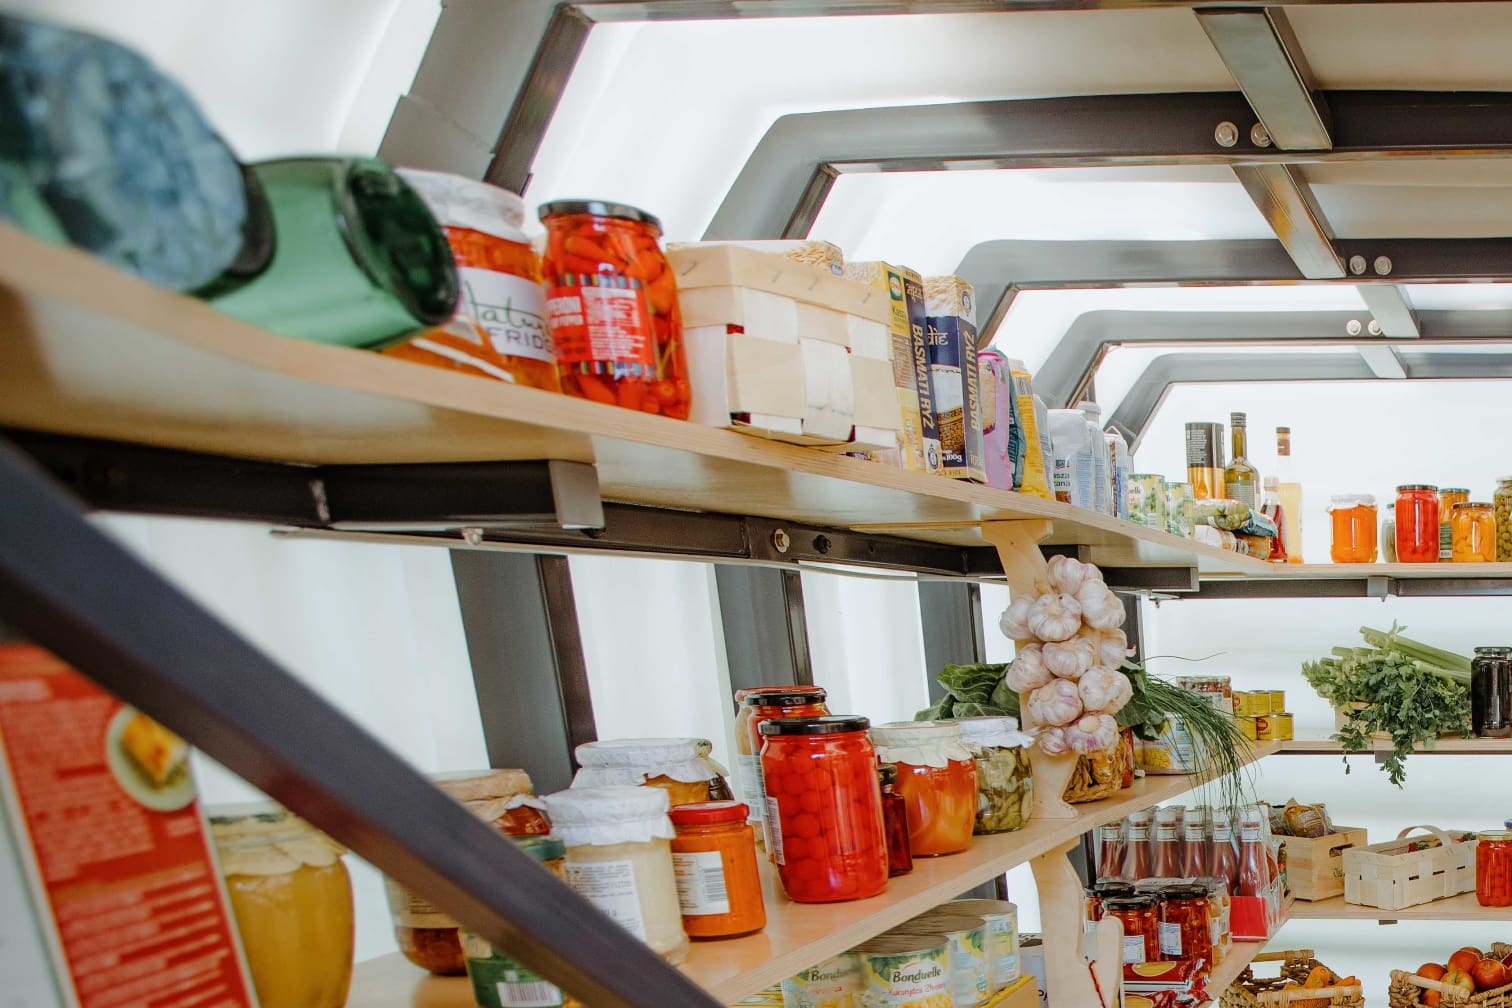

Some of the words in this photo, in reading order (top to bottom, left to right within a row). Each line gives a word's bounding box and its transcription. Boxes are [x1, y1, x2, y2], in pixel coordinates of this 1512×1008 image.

[912, 323, 930, 392] BASMATI
[963, 365, 979, 431] BASMATI
[892, 965, 942, 983] Bonduelle
